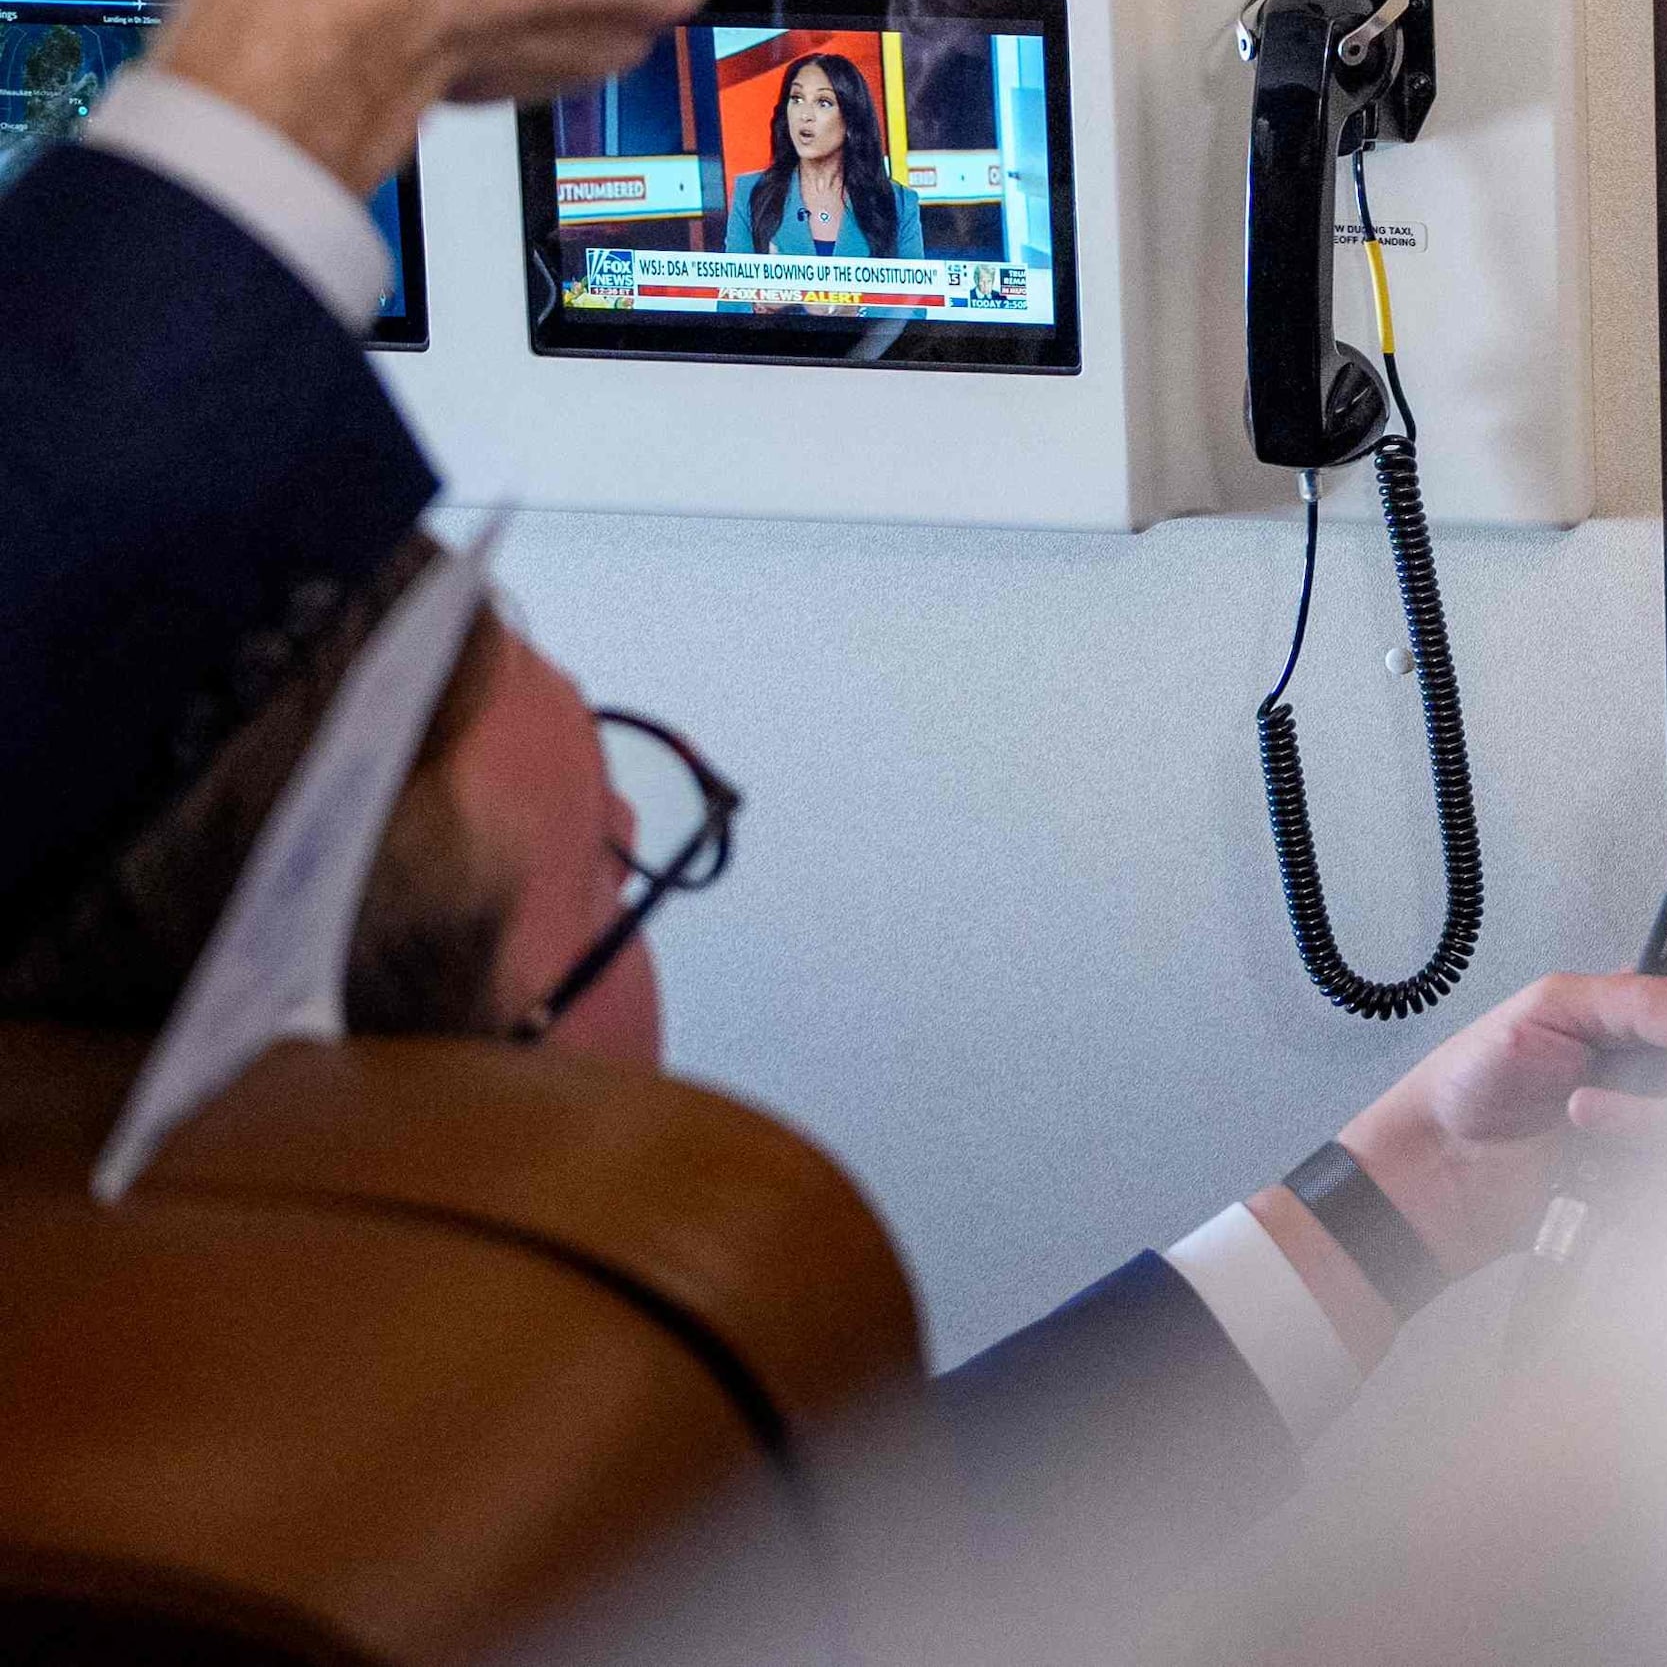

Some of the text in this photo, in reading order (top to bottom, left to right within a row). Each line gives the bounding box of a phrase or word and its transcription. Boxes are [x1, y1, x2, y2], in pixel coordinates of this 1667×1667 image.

[1389, 226, 1414, 237] TAXI,
[1378, 237, 1416, 247] ANDING
[603, 259, 632, 274] FOX
[639, 259, 665, 277] WSJ:
[667, 261, 688, 277] DSA
[763, 264, 814, 281] BLOWING
[817, 266, 831, 282] UP
[833, 266, 851, 282] THE
[595, 273, 634, 287] NEWS
[729, 288, 862, 304] FOX NEWS ALERT
[971, 299, 1001, 308] TODAY
